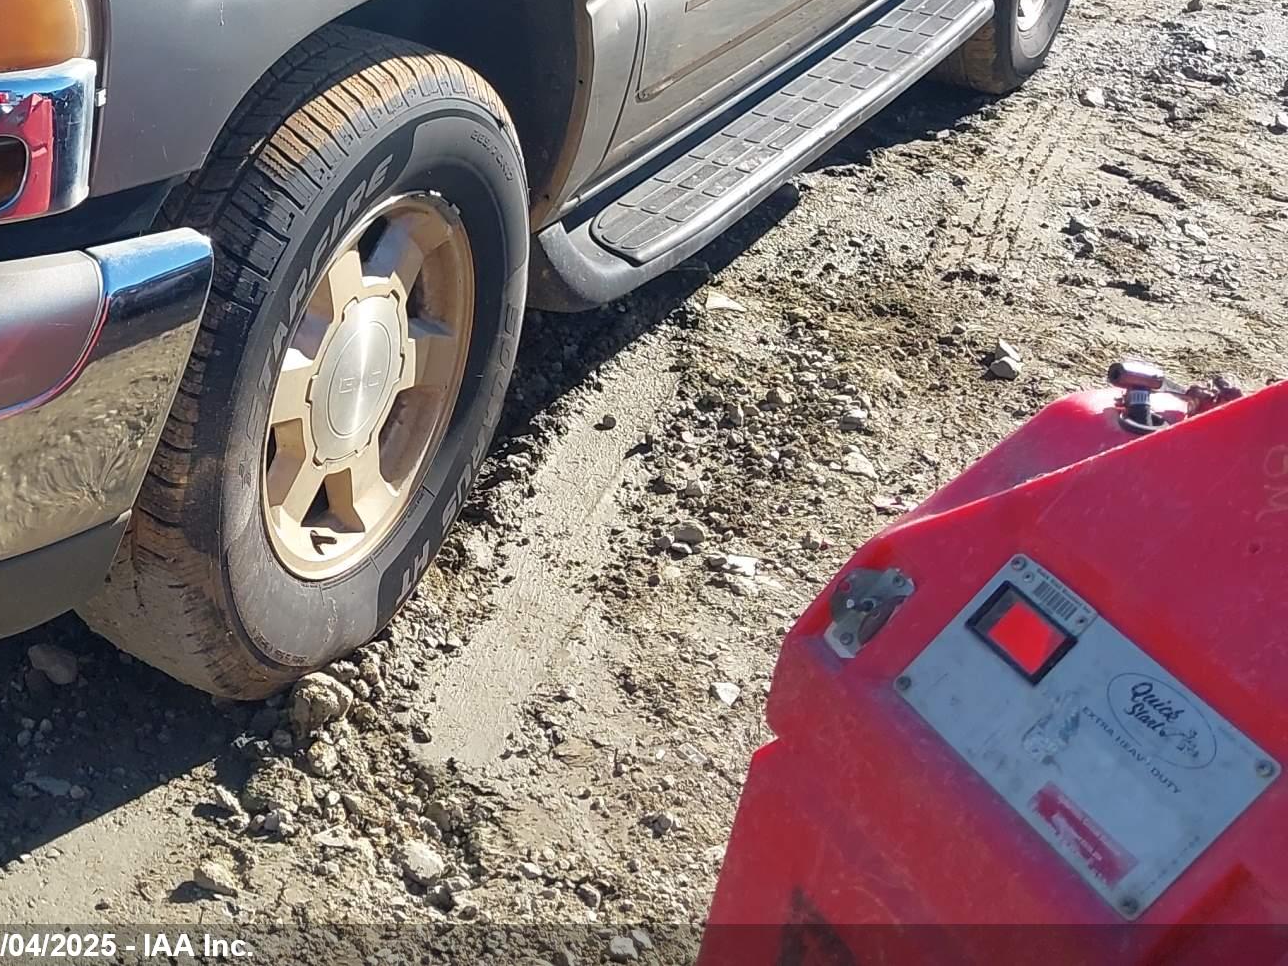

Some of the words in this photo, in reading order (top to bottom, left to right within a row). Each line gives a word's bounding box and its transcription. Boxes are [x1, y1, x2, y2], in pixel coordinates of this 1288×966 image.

[246, 152, 394, 441] STARFIRE
[395, 539, 431, 598] HT
[1122, 701, 1166, 731] Start
[1130, 681, 1185, 724] Quick
[1082, 705, 1114, 737] EXTRA
[1151, 767, 1182, 794] DUTY
